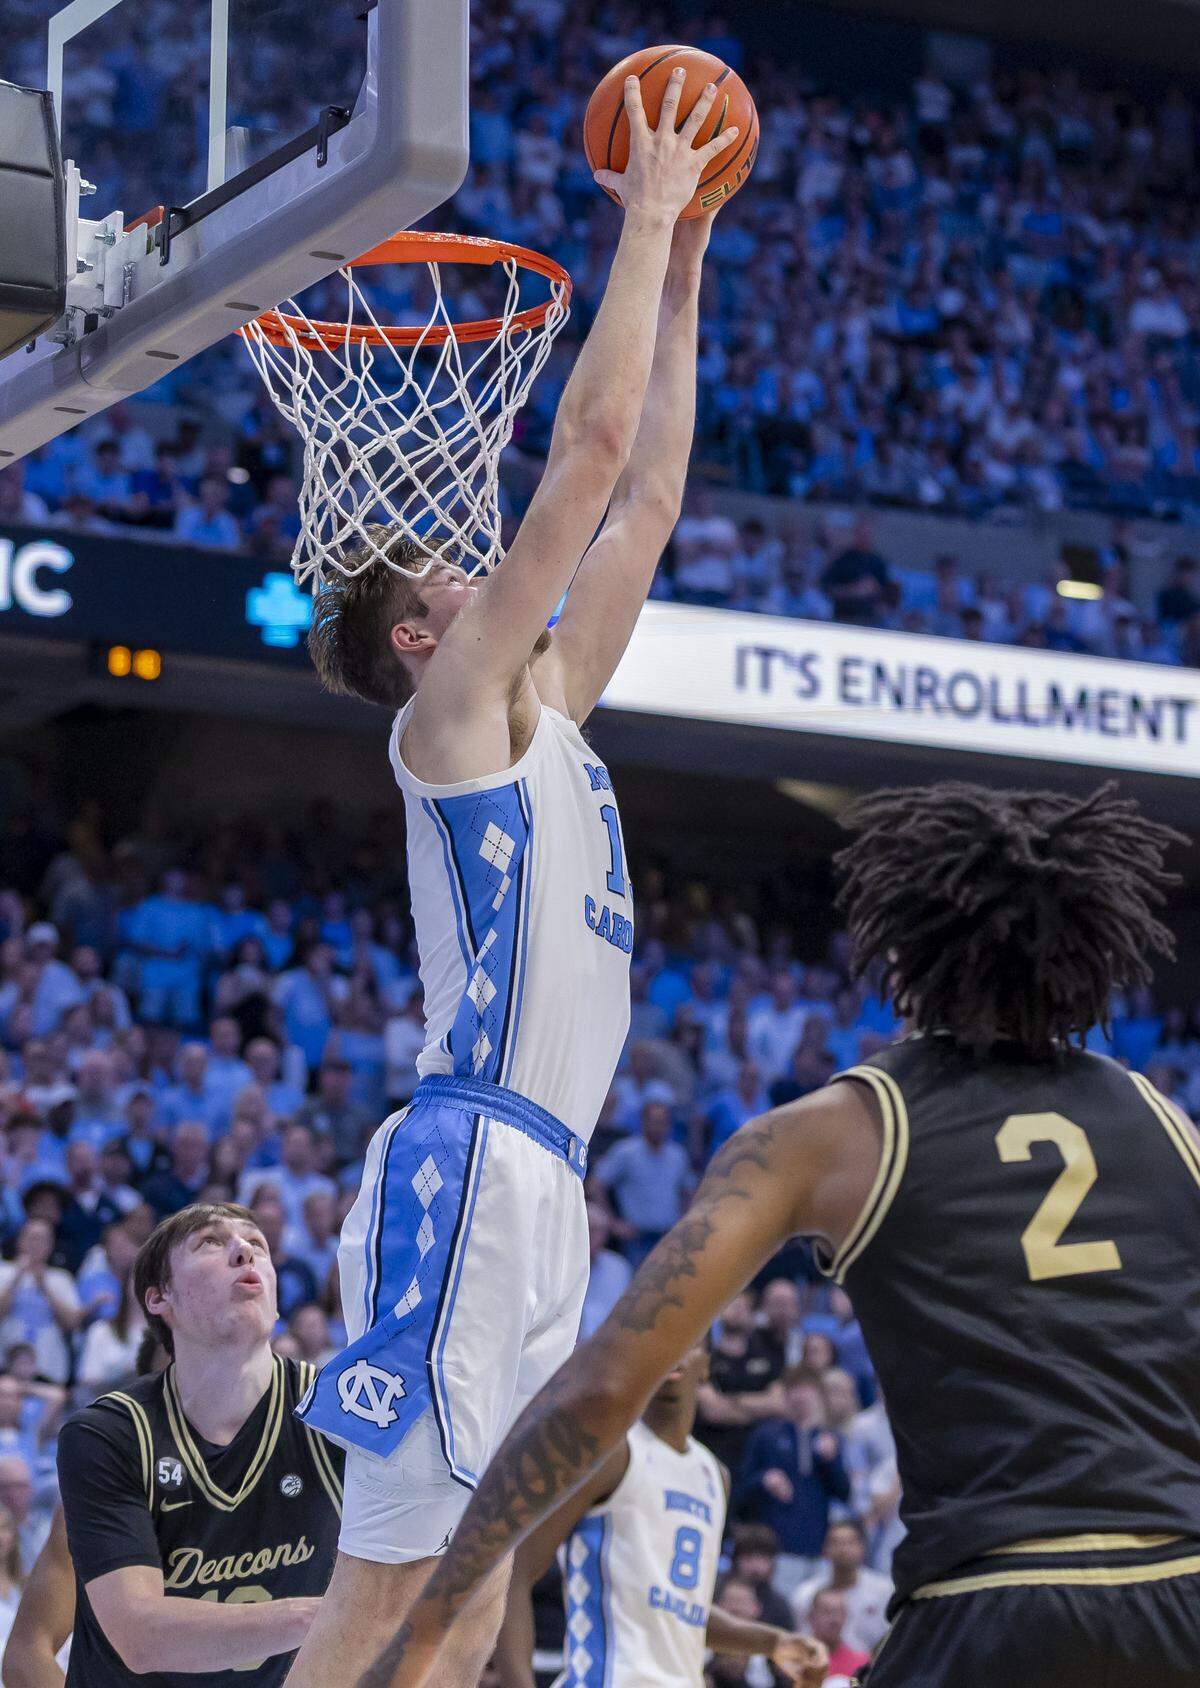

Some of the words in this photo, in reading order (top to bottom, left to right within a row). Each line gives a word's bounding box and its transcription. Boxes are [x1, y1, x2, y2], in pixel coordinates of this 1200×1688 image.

[735, 643, 821, 699] IT'S
[838, 654, 1196, 744] ENROLLMENT
[995, 1111, 1122, 1281] 2
[158, 1461, 183, 1486] 54
[164, 1536, 315, 1589] Deacons
[670, 1526, 702, 1590] 8
